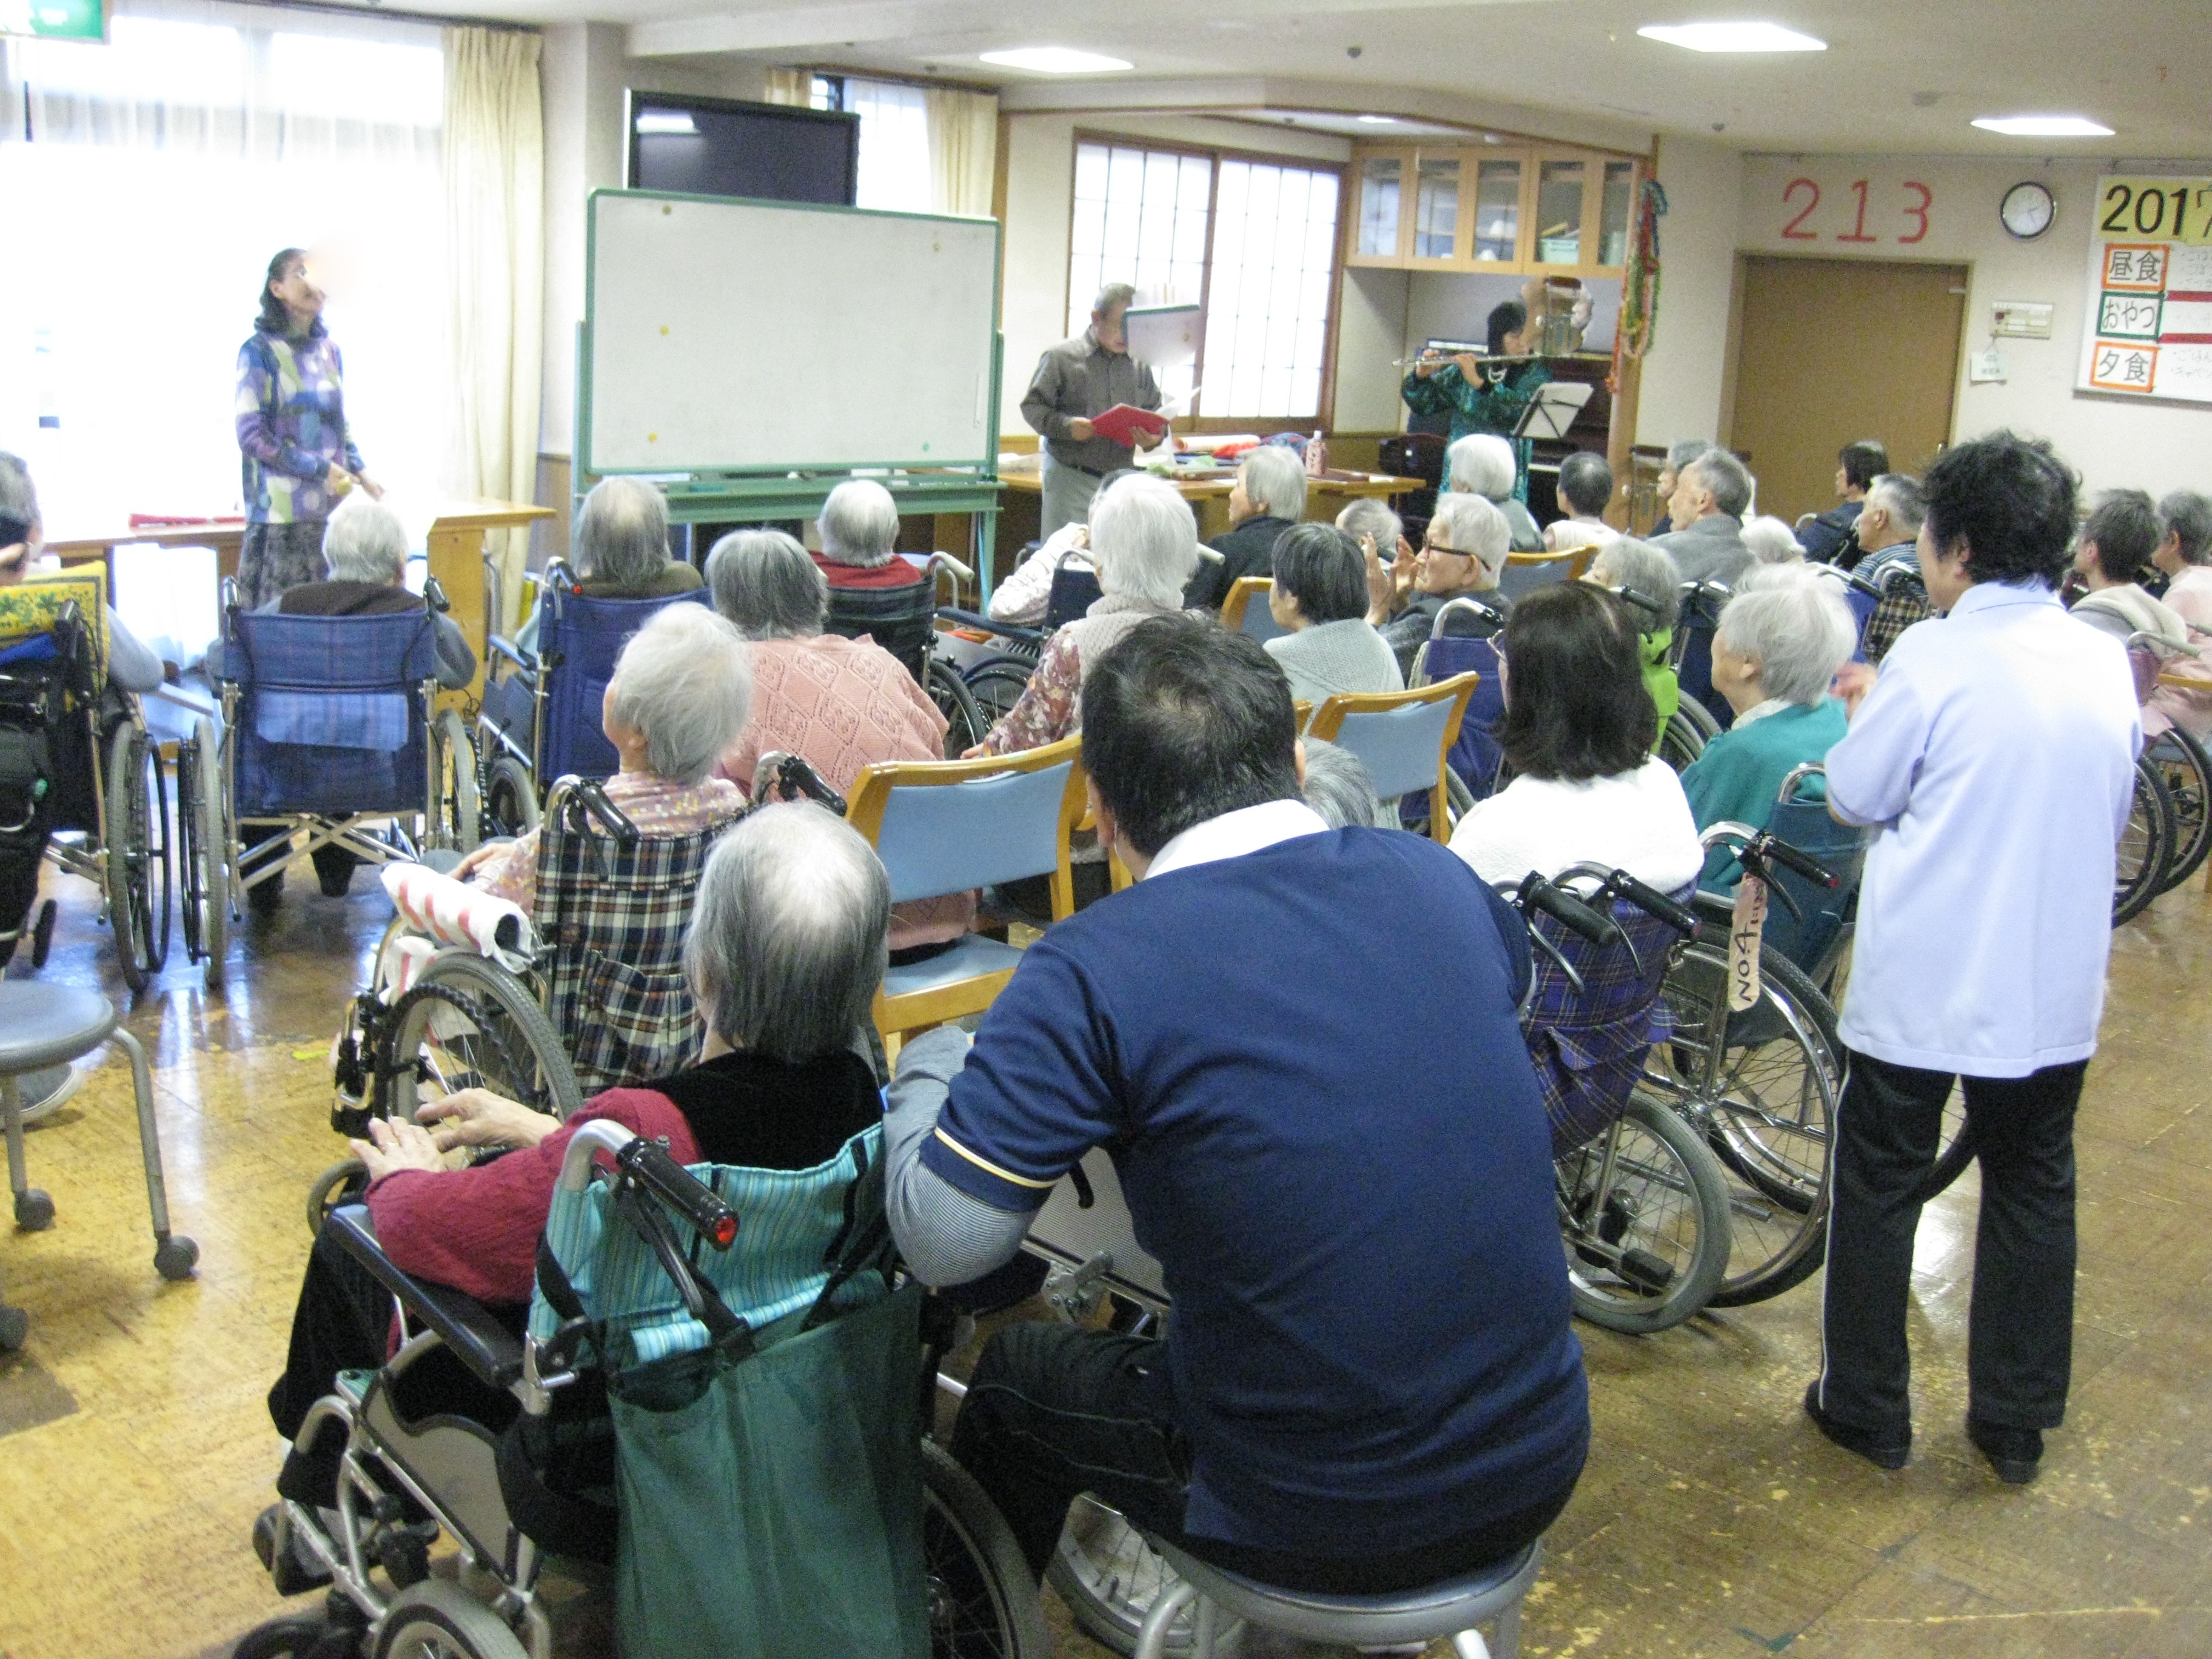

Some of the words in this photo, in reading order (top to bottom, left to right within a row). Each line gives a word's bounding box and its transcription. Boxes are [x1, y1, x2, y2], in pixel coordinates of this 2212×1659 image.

[1781, 178, 1932, 243] 213
[2109, 250, 2160, 282] 昼食
[2102, 298, 2156, 329] おやつ
[2098, 349, 2149, 383] 夕食
